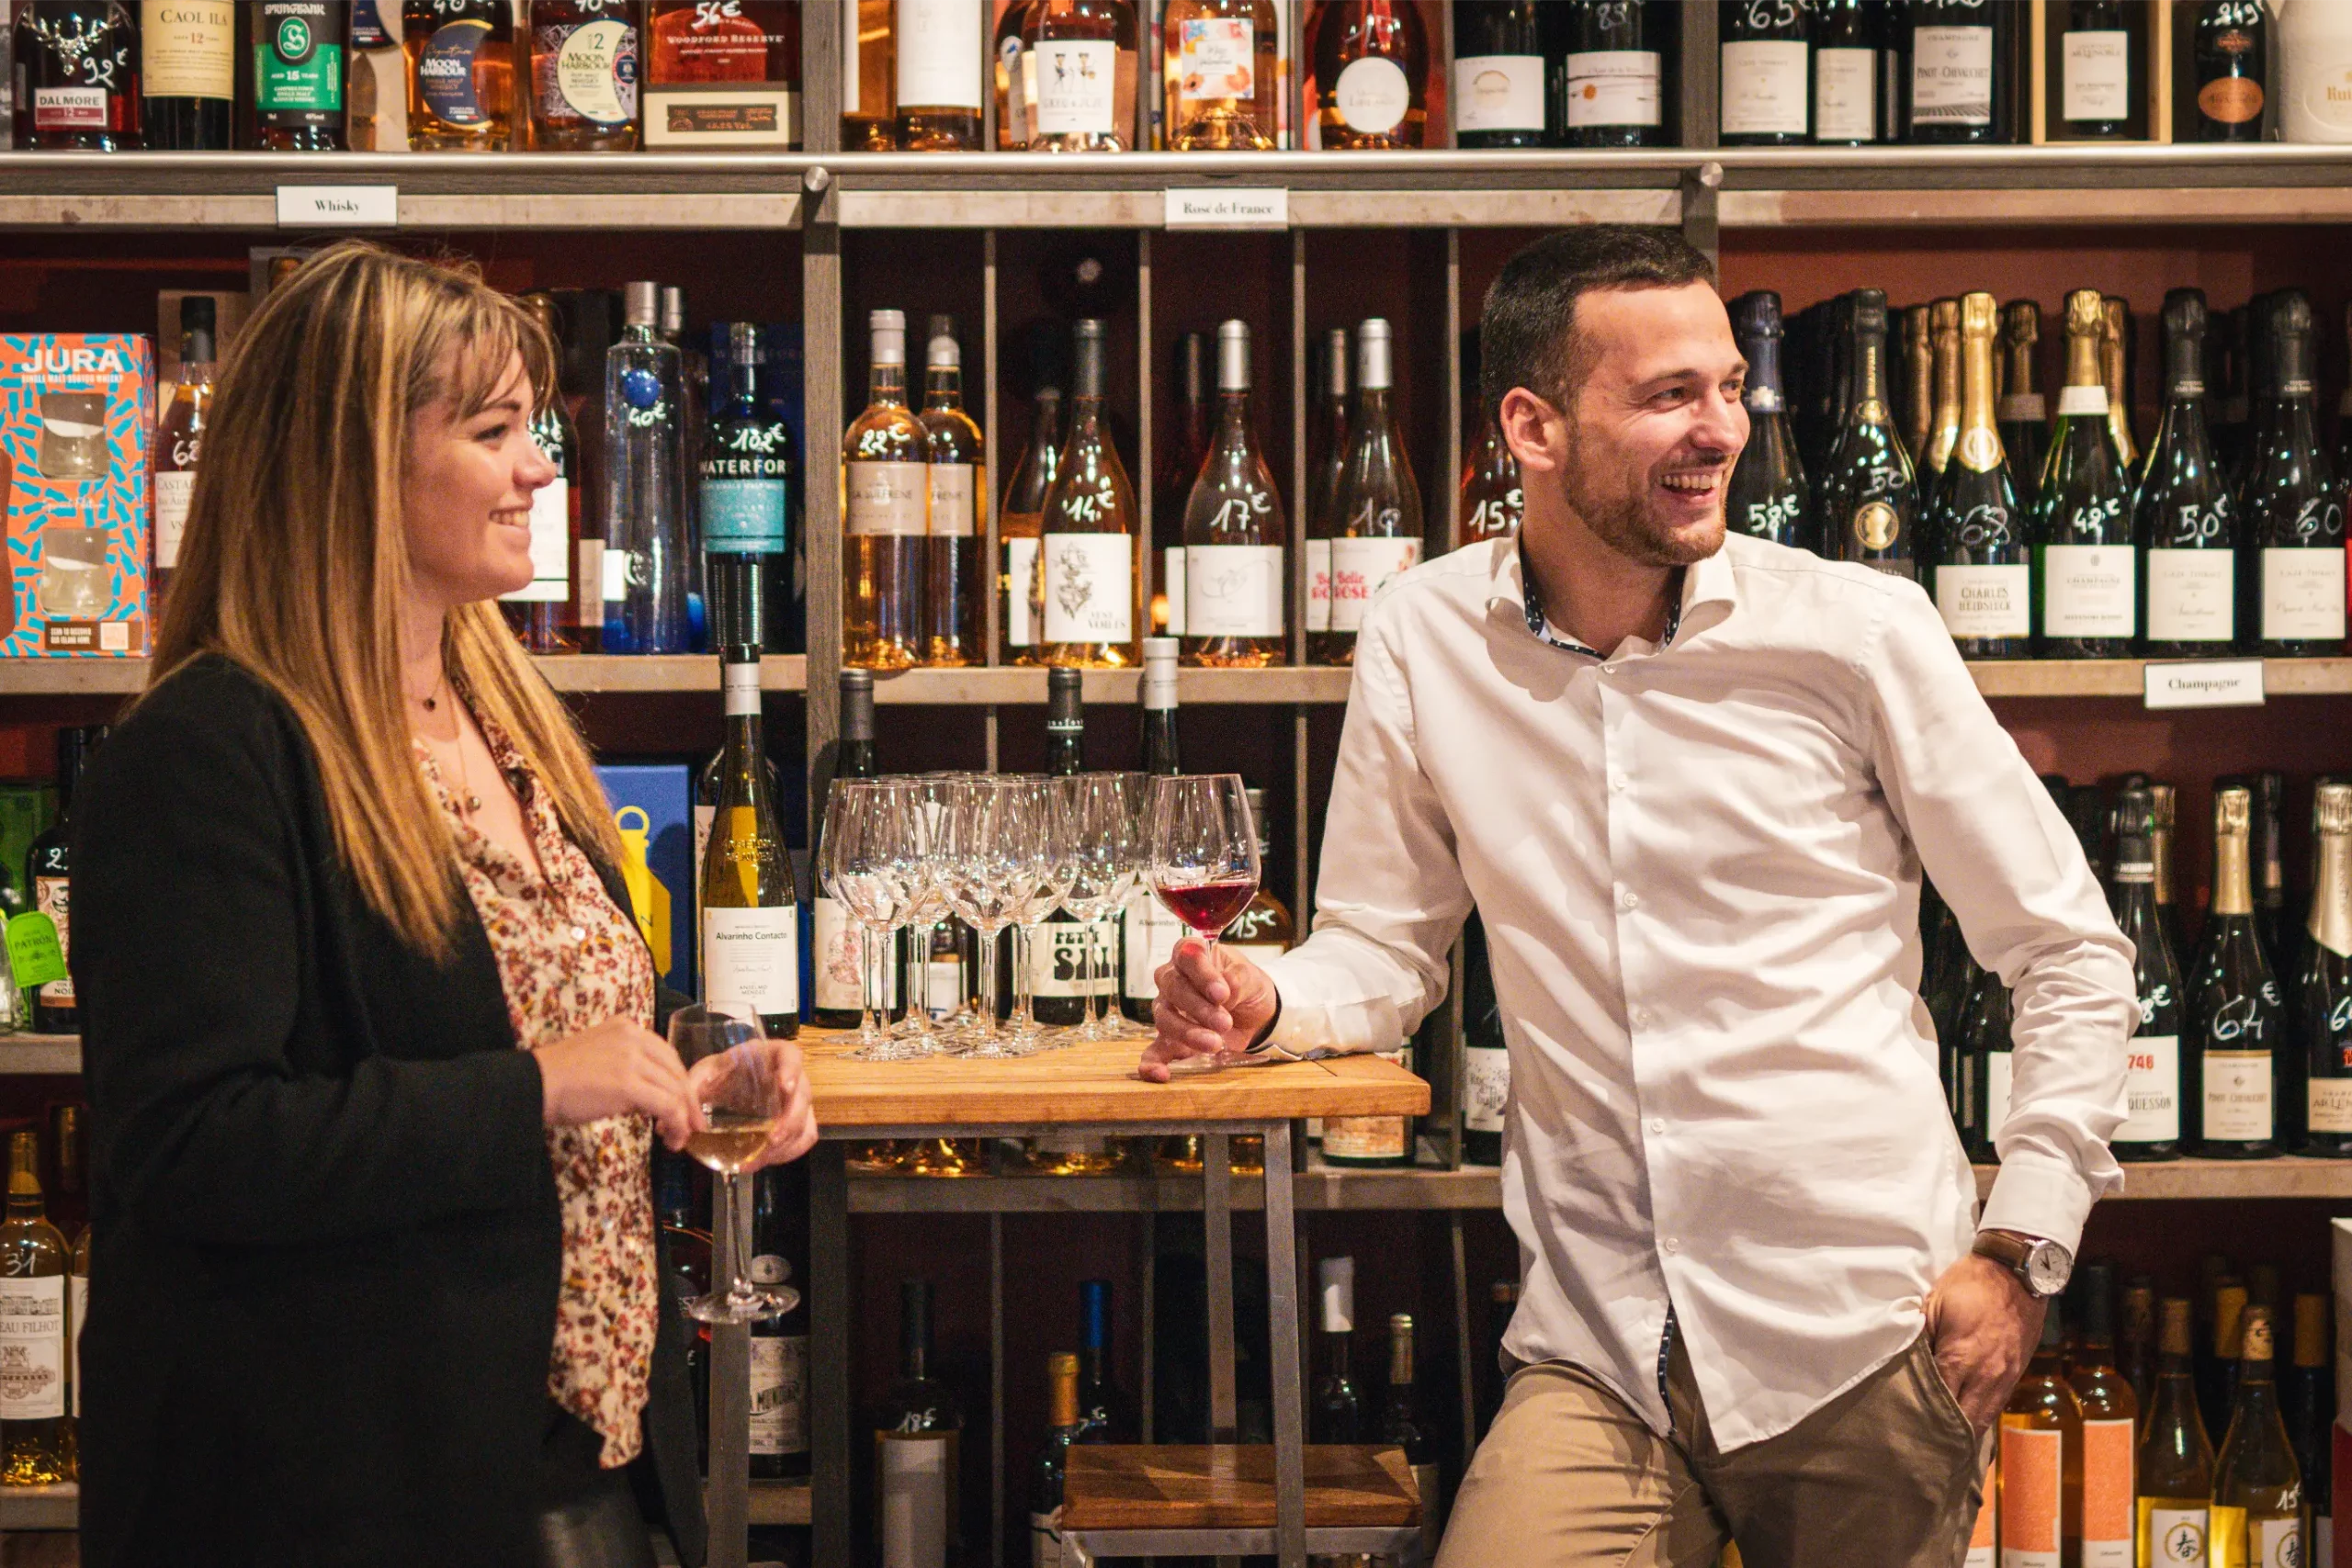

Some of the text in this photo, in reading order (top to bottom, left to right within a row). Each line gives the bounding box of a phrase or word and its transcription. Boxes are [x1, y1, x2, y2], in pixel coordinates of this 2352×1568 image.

[160, 9, 229, 26] CAOL ILA
[265, 4, 325, 15] SPRINGBANK
[691, 0, 742, 29] 56€
[190, 32, 204, 44] 12
[667, 34, 783, 44] WOODFORD RESERVE
[424, 59, 460, 68] MOON
[569, 52, 605, 62] MOON
[83, 47, 129, 89] 92€
[562, 61, 610, 70] HARBOUR
[287, 70, 300, 81] 15
[40, 96, 100, 106] DALMORE
[315, 198, 359, 215] Whisky
[1183, 201, 1273, 214] Rosé de France
[21, 348, 125, 372] JURA
[628, 402, 667, 427] 40€
[730, 423, 786, 453] 102€
[859, 423, 911, 455] 22€
[700, 458, 787, 474] WATERFOR
[1210, 491, 1272, 532] 17€
[1468, 488, 1524, 535] 15€
[1747, 493, 1801, 533] 58€
[2174, 493, 2229, 544] 50€
[2296, 498, 2342, 537] 60
[1961, 588, 2010, 599] CHARLES
[1958, 601, 2012, 611] HEIDSIECK
[2167, 678, 2241, 692] Champagne
[1227, 909, 1276, 939] 15€
[716, 931, 787, 941] Alvarinho Contacto
[2213, 981, 2280, 1041] 64€
[2128, 1098, 2172, 1110] QUESSON
[6, 1252, 36, 1276] 31
[22, 1320, 60, 1333] FILHOT
